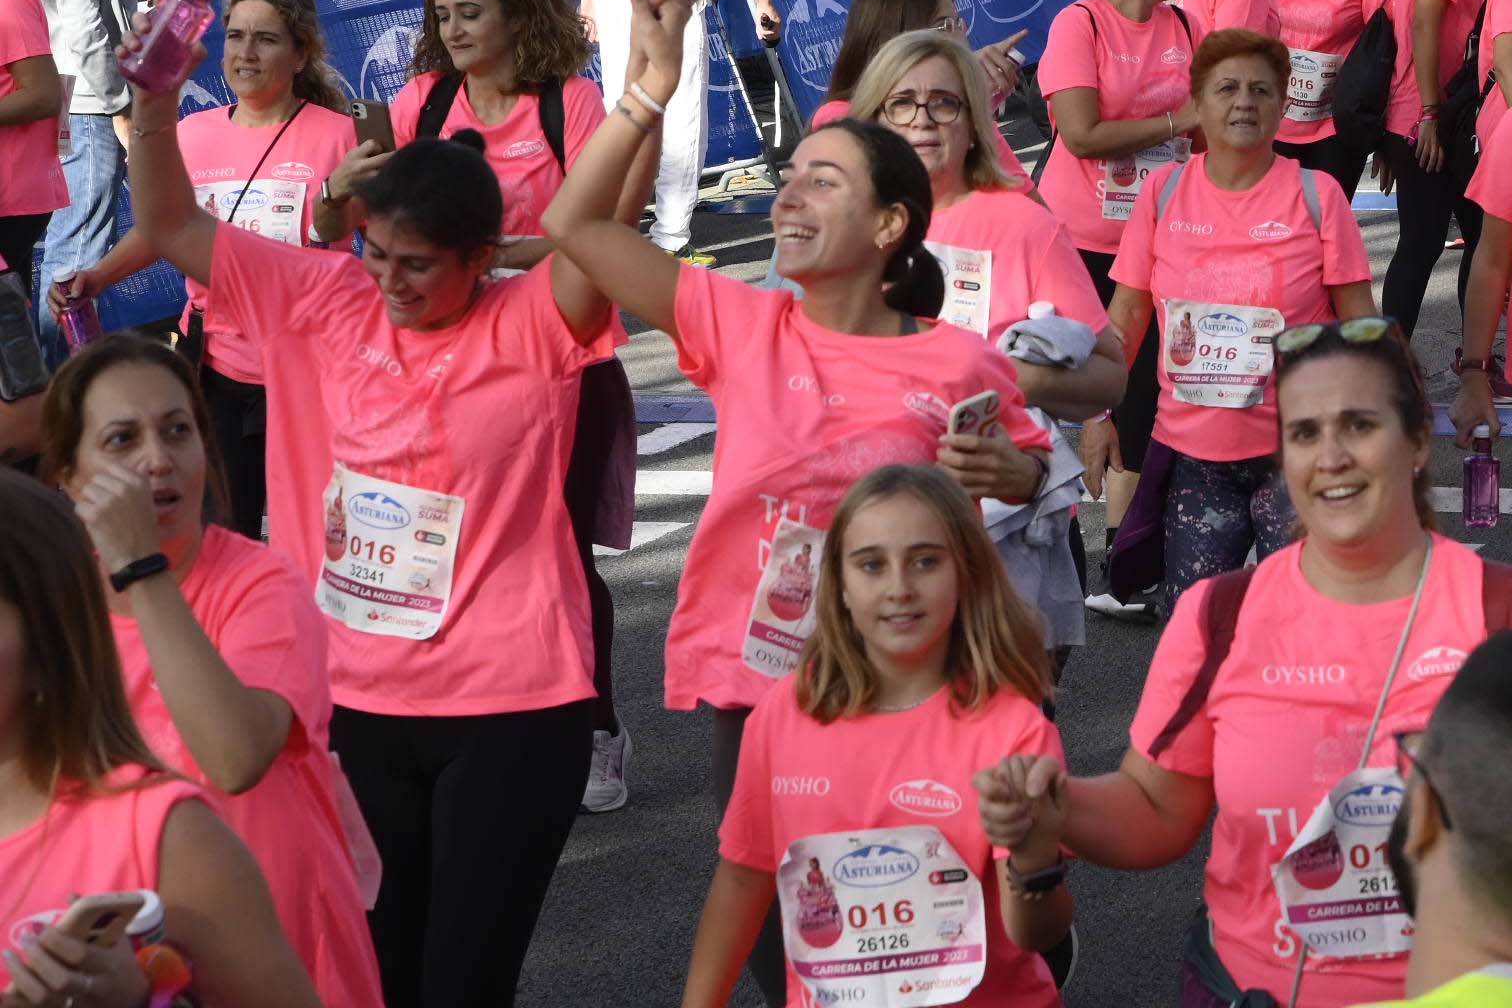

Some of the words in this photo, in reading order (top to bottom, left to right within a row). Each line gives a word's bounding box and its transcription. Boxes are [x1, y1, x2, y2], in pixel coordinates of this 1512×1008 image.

[1290, 77, 1313, 90] 016
[1201, 318, 1245, 334] ASTURIANA
[1199, 344, 1237, 360] 016
[353, 501, 404, 525] ASTURIANA
[418, 510, 448, 523] SUMA
[351, 536, 395, 564] 016
[350, 563, 384, 584] 32341
[372, 590, 406, 603] MUJER
[409, 597, 431, 608] 2023
[1262, 664, 1345, 686] OYSHO
[895, 792, 956, 811] ASTURIANA
[839, 862, 913, 880] ASTURIANA
[849, 900, 915, 930] 016
[1308, 903, 1363, 919] CARRERA
[1366, 900, 1382, 914] DE
[1385, 899, 1399, 912] LA
[857, 933, 910, 953] 26126
[1308, 928, 1366, 946] OYSHO
[812, 960, 861, 976] CARRERA
[863, 959, 880, 973] DE
[882, 957, 897, 970] LA
[900, 953, 939, 968] MUJER
[914, 975, 971, 992] Santander
